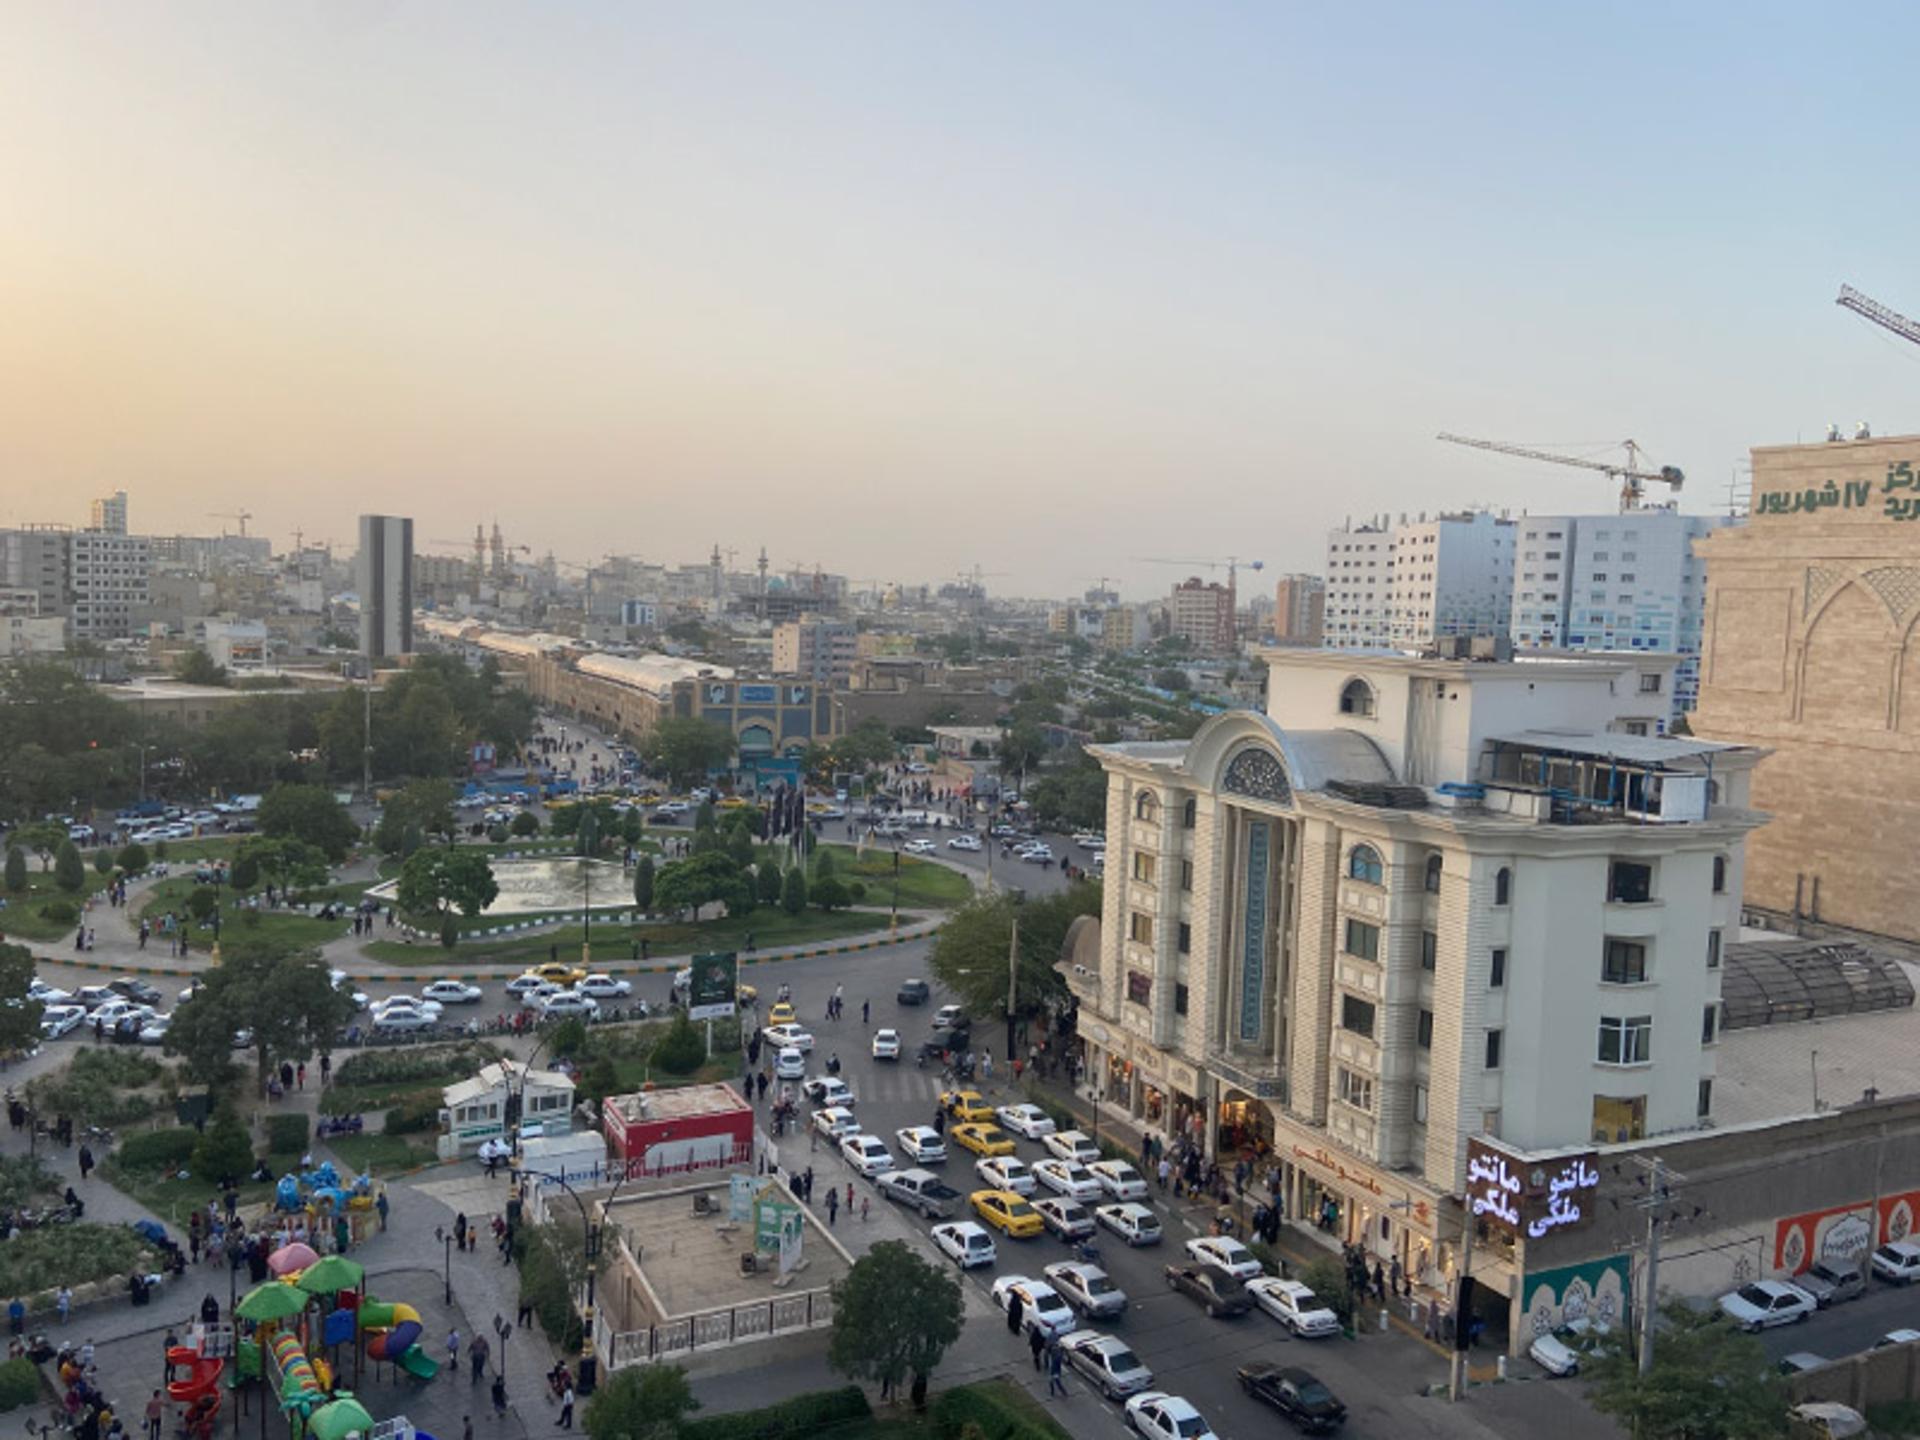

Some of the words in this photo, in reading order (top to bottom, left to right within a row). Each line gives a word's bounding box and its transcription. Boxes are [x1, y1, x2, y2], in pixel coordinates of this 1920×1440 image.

[1881, 461, 1920, 493] رکز
[1756, 479, 1840, 514] شهریور
[1884, 496, 1920, 521] رید
[1336, 1165, 1383, 1196] مانتو
[1467, 1154, 1520, 1194] مانتو
[1548, 1160, 1600, 1203] مانتو
[1466, 1189, 1519, 1226] ملکی
[1528, 1196, 1580, 1237] ملکی
